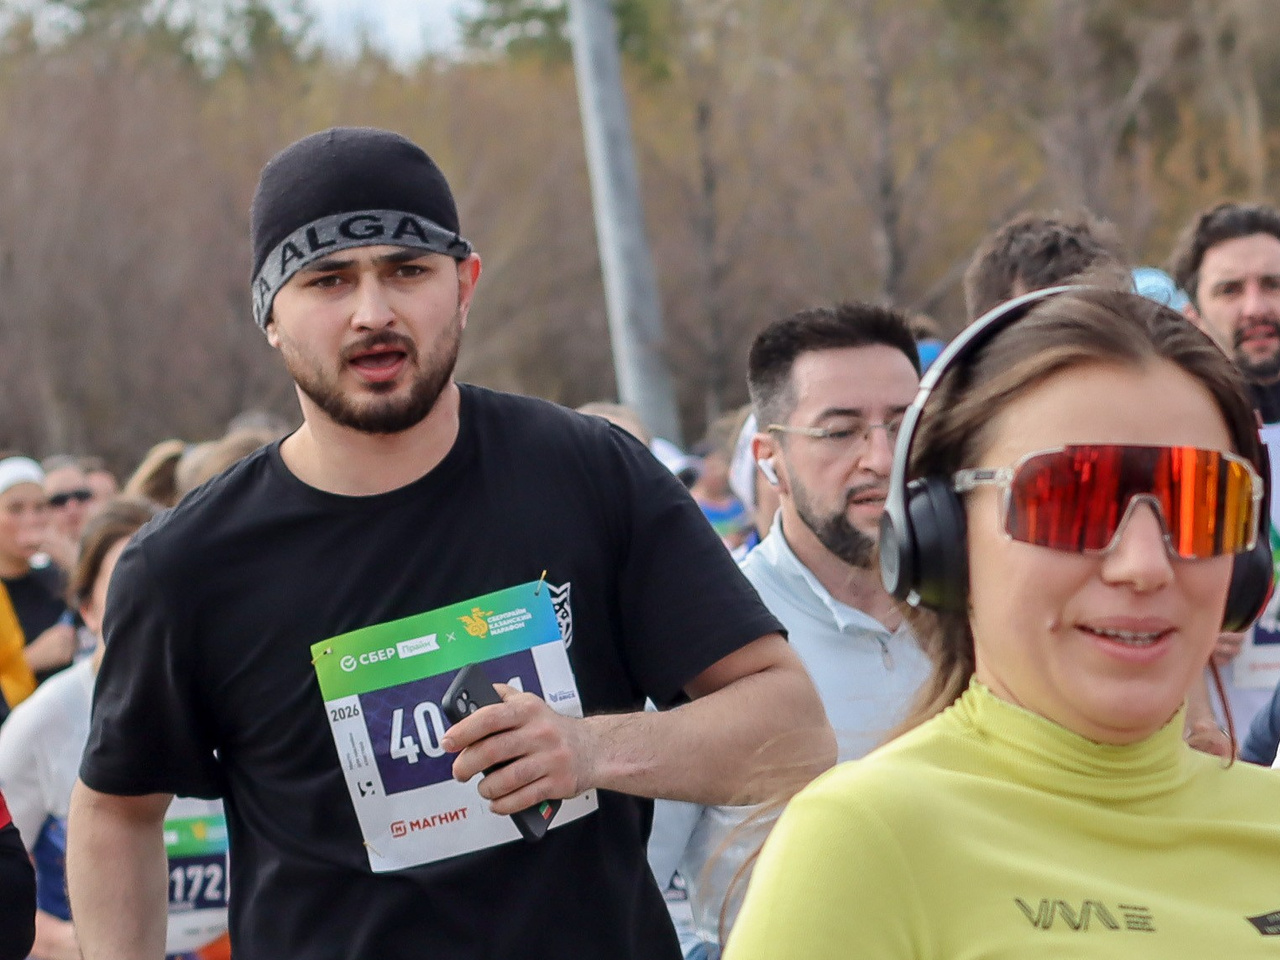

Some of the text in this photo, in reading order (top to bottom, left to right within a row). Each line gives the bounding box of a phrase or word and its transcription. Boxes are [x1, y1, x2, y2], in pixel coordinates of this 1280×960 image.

[280, 214, 430, 275] ALGA
[359, 648, 396, 666] СБЕР
[331, 704, 360, 722] 2026
[409, 807, 468, 832] МАГНИТ
[170, 863, 223, 901] 172
